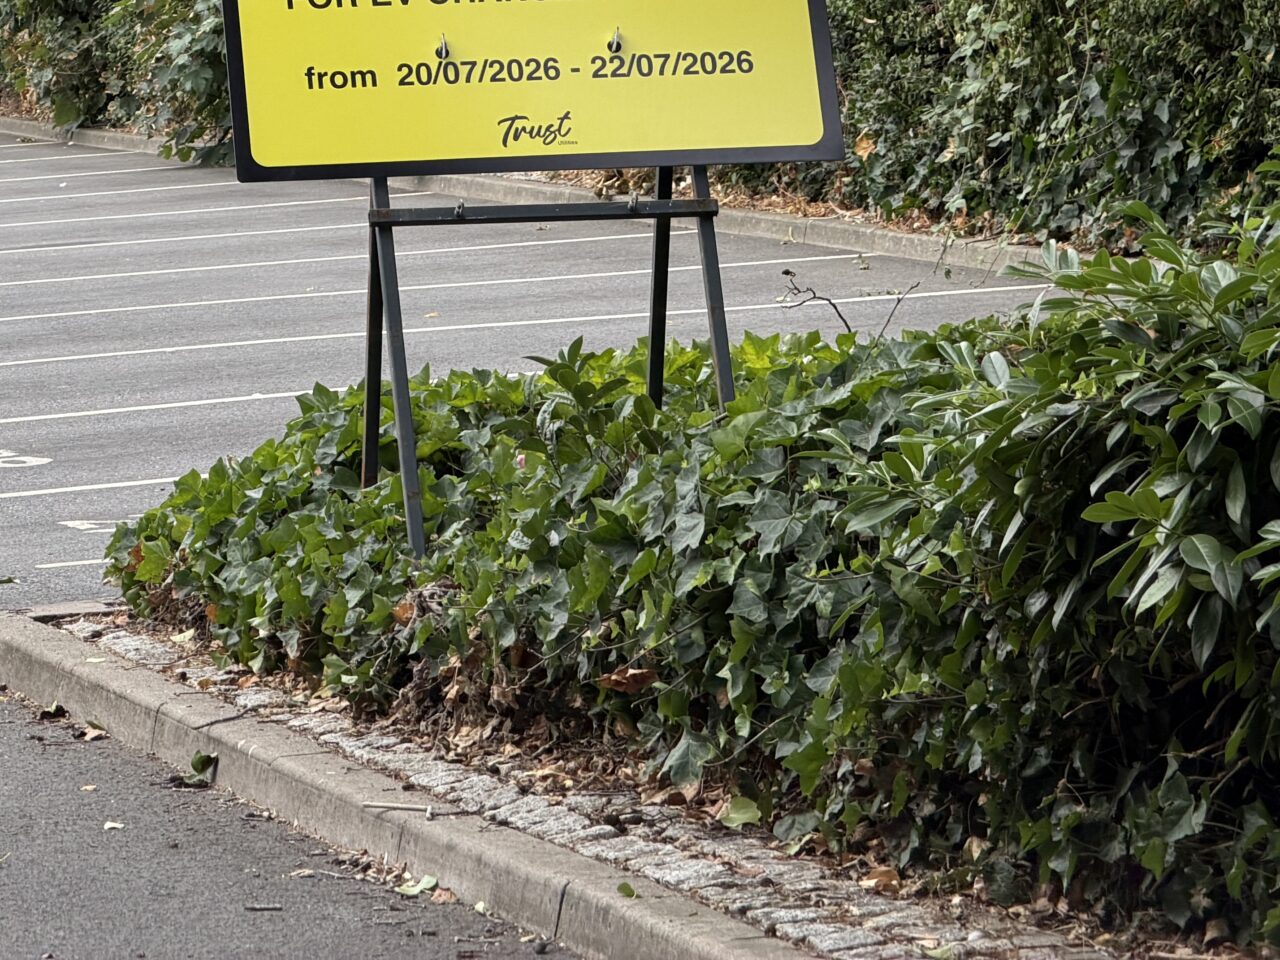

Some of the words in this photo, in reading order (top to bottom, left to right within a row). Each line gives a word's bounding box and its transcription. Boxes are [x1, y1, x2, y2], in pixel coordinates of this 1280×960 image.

[304, 67, 378, 90] from
[396, 57, 561, 87] 20/07/2026
[590, 50, 754, 79] 22/07/2026
[498, 110, 572, 148] Trust
